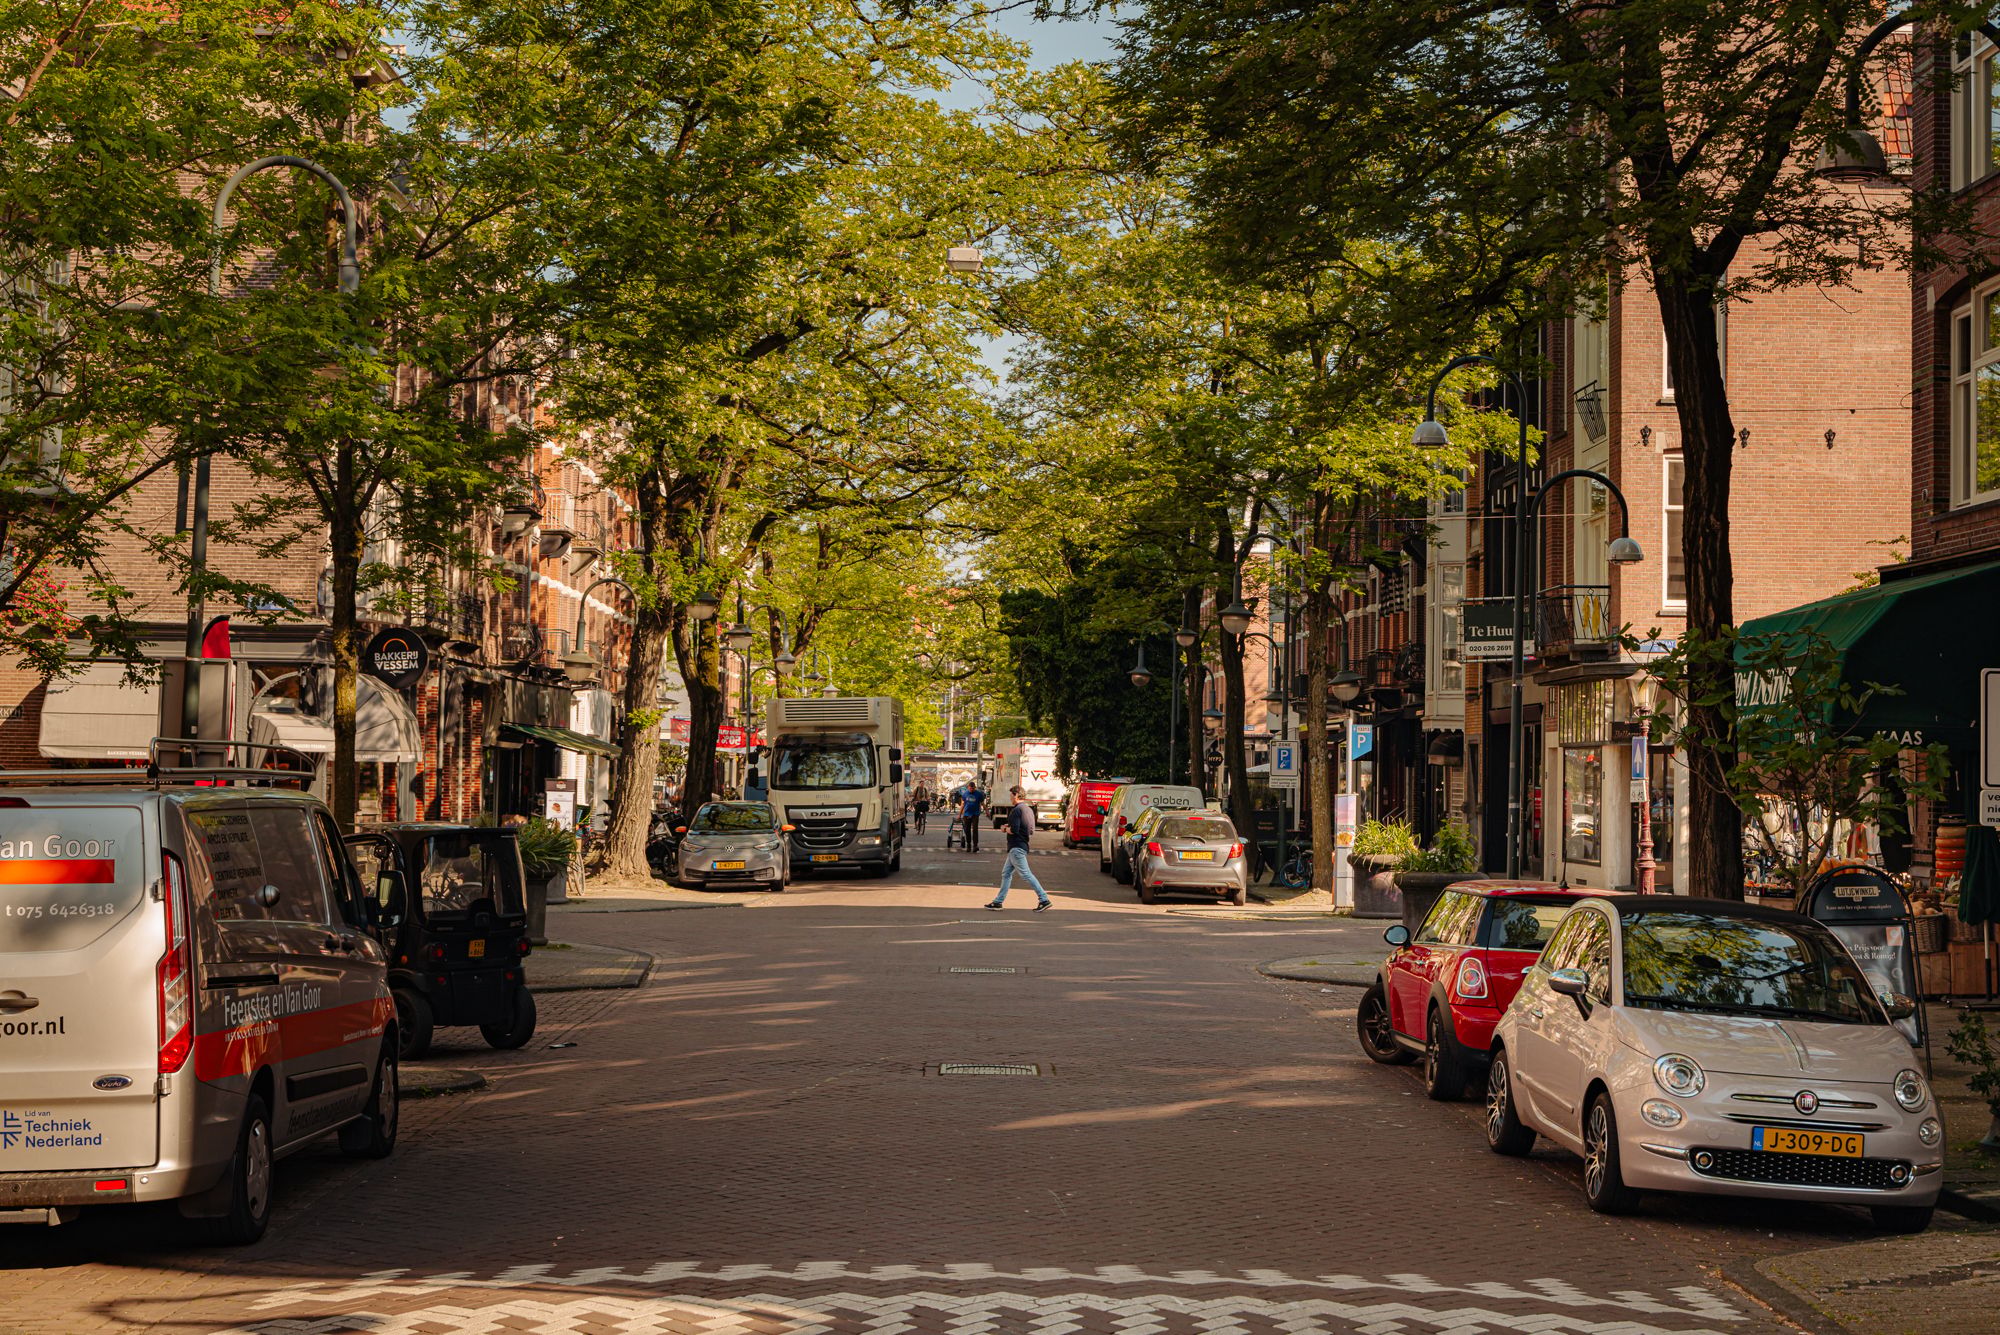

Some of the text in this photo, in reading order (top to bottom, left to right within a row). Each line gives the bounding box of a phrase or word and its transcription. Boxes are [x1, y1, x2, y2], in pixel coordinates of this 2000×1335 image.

[1468, 625, 1515, 637] Te Huu
[374, 650, 419, 661] BAKKERIJ
[374, 660, 419, 670] VESSEM
[1357, 734, 1366, 749] P
[1280, 749, 1289, 761] P
[1152, 795, 1190, 806] globen
[0, 834, 116, 859] an Goor
[1837, 887, 1877, 897] LUTJEWINKEL
[6, 903, 115, 919] t 075 6426318
[224, 982, 322, 1027] Feenstra en Van Goor
[0, 1016, 66, 1038] oor.nl
[1801, 1097, 1814, 1108] FIAT
[24, 1118, 92, 1133] Techniek
[25, 1133, 103, 1149] Nederland
[1769, 1132, 1857, 1154] J-309-DG
